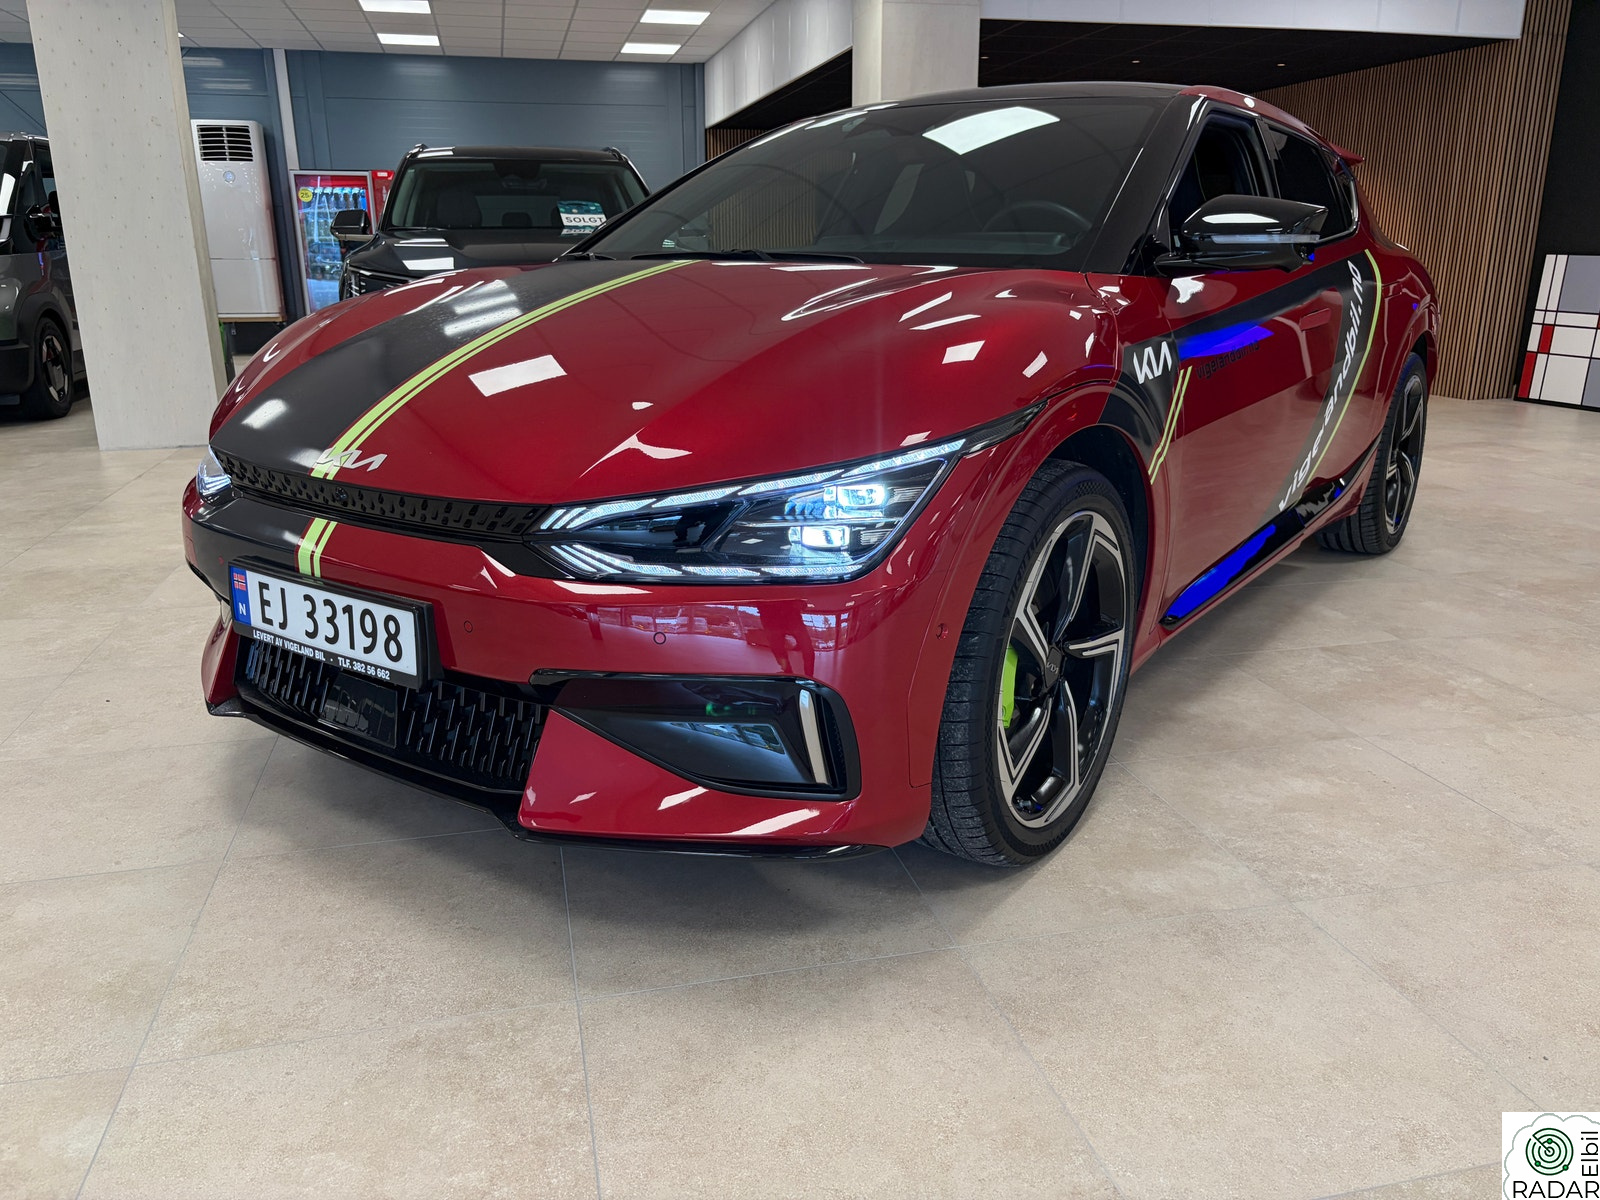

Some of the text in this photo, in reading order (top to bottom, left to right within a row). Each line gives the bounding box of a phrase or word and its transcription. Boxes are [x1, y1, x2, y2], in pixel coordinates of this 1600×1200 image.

[565, 216, 604, 224] SOLGT
[1133, 341, 1172, 384] KIA
[1278, 260, 1363, 511] vigelandbil.no
[315, 447, 388, 472] KIA
[238, 602, 247, 616] N
[258, 581, 403, 663] EJ 33198
[252, 629, 391, 680] LEVERT AV VIGELAND BIL TLF. 382 56 662
